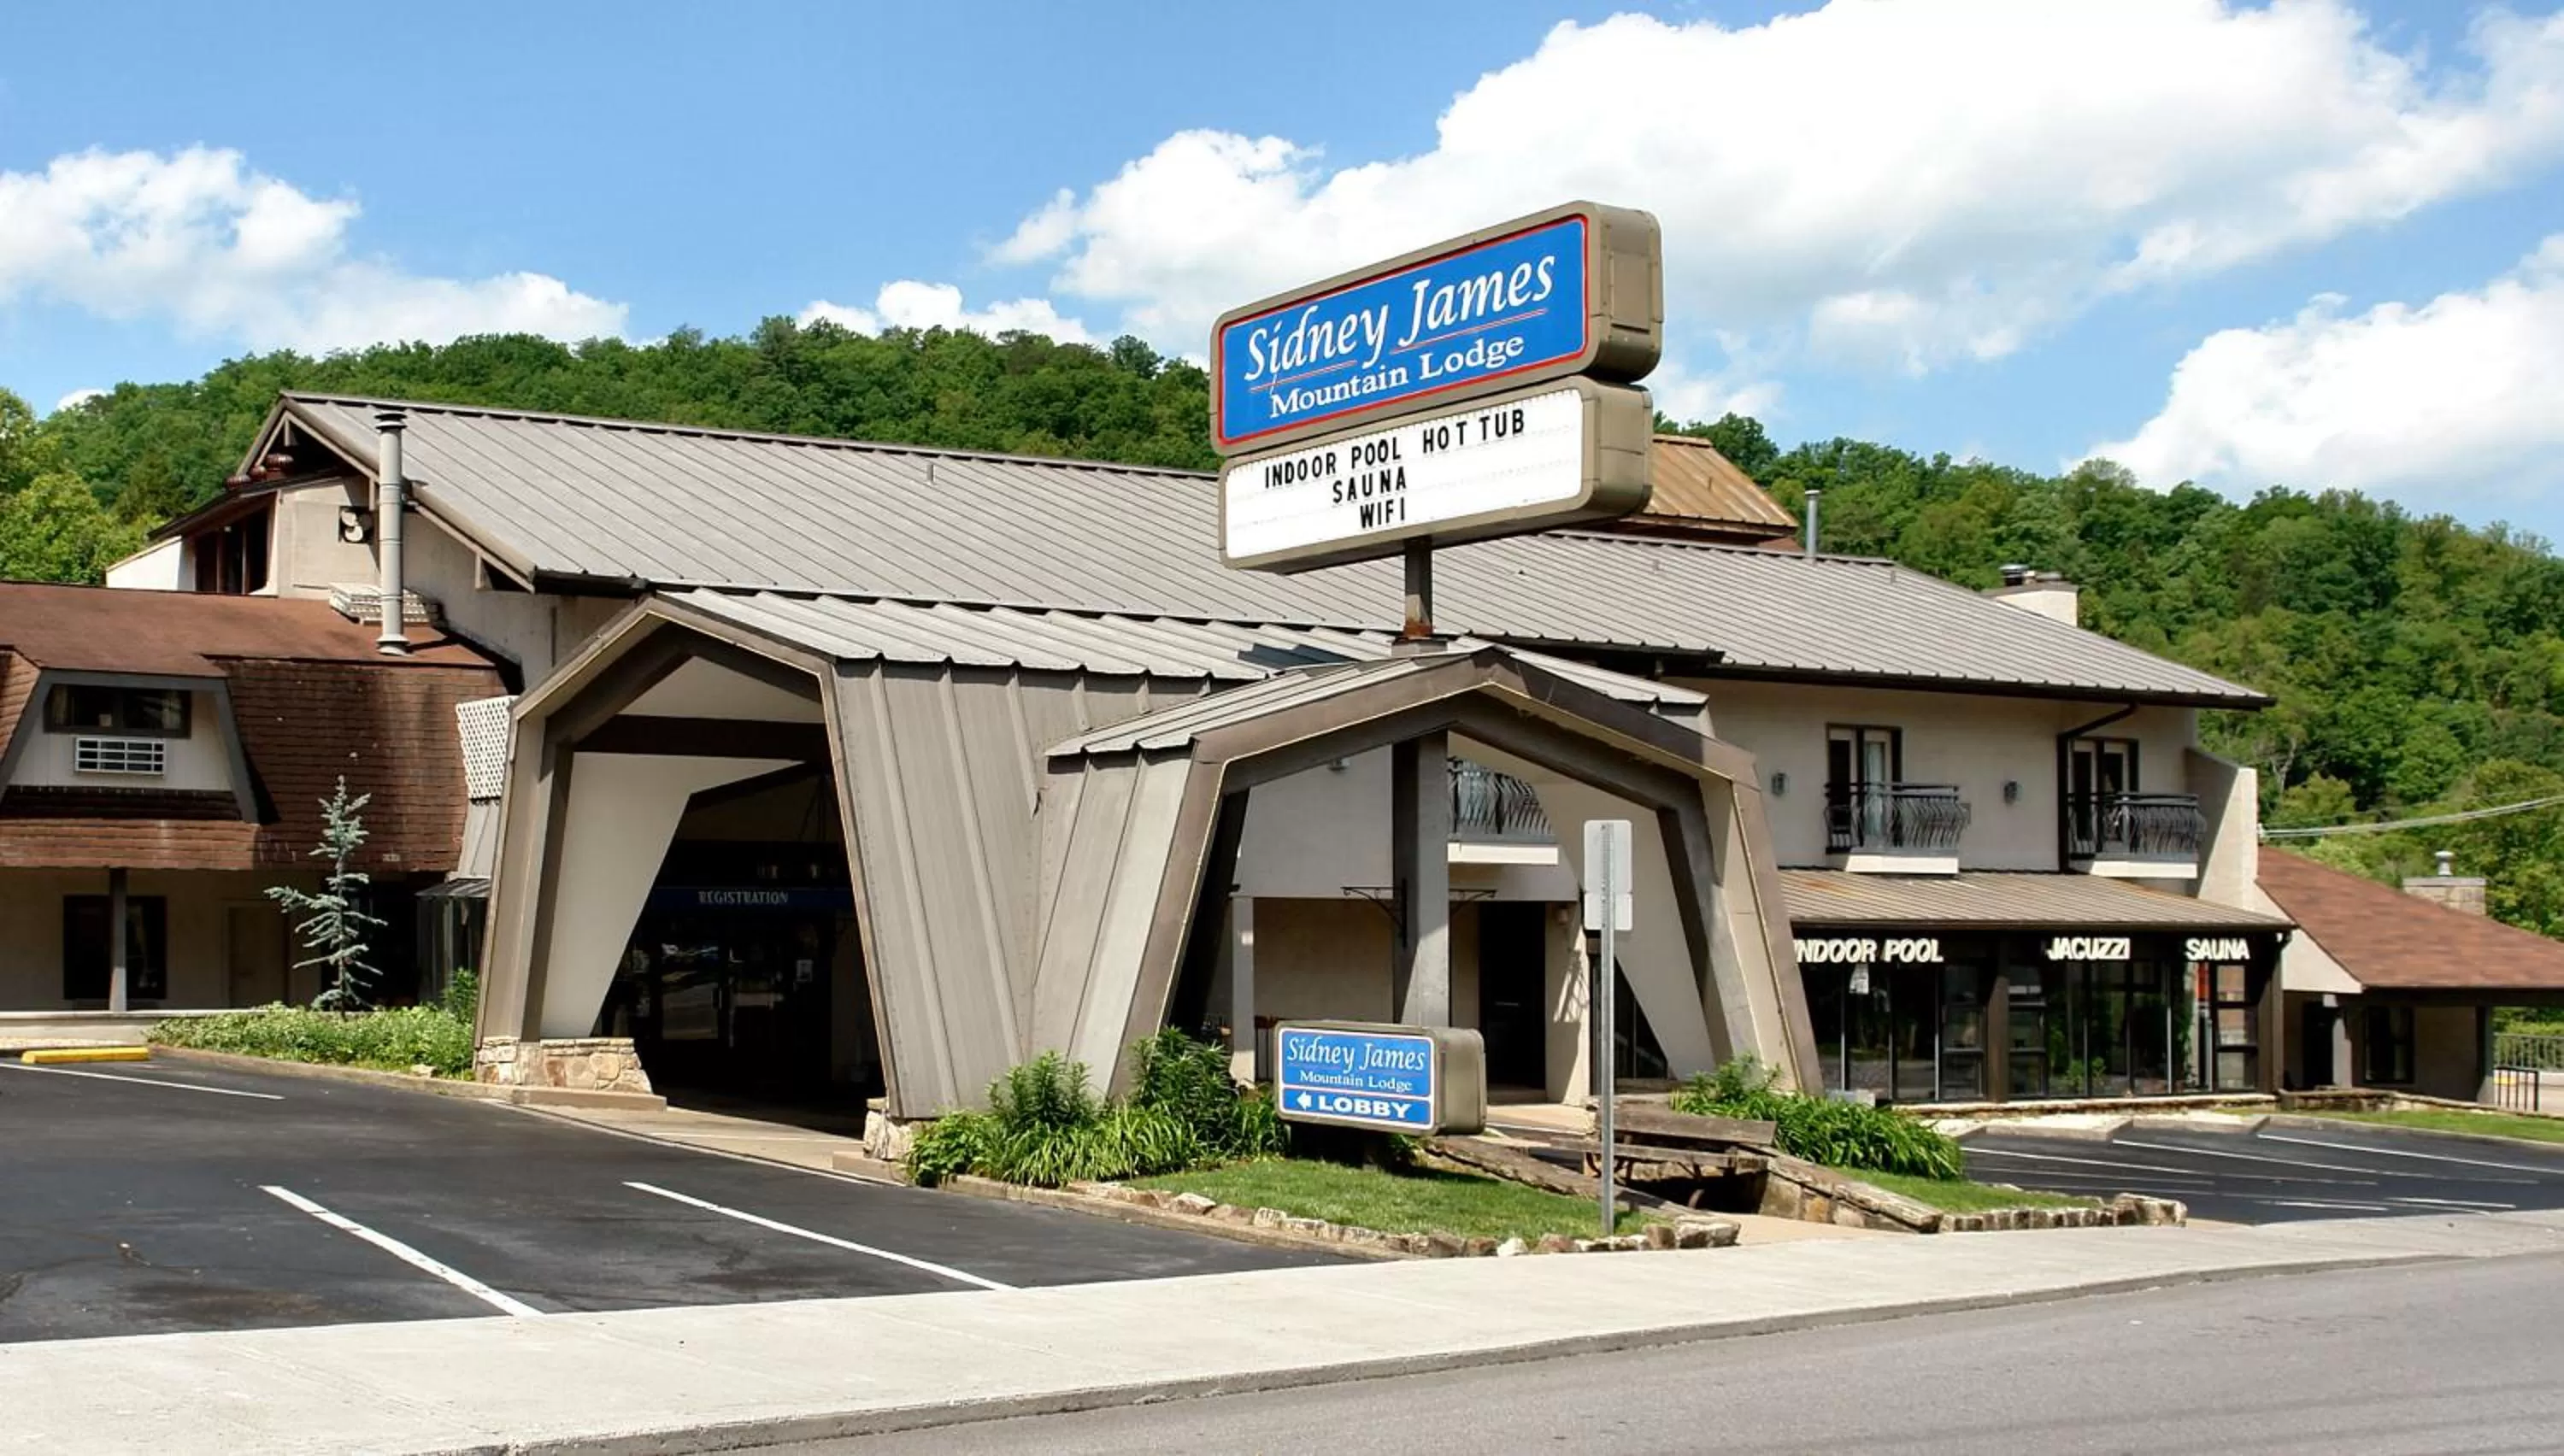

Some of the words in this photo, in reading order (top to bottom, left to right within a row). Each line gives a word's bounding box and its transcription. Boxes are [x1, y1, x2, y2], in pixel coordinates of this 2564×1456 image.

[1245, 305, 1391, 381] Sidney
[1398, 255, 1555, 346] James
[1270, 367, 1408, 417] Mountain
[1420, 335, 1525, 379] Lodge
[1265, 451, 1338, 489] INDOOR
[1351, 436, 1403, 471] POOL
[1422, 421, 1465, 455] HOT
[1479, 408, 1526, 443] TUB
[1332, 467, 1408, 503] SAUNA
[1359, 498, 1407, 530] WIFI
[698, 891, 788, 904] REGISTRATION
[1883, 938, 1944, 963] POOL
[2046, 936, 2131, 961] JACUZZI
[2185, 938, 2250, 960] SAUNA
[1287, 1036, 1355, 1073] Sidney
[1358, 1042, 1426, 1071] James
[1299, 1070, 1363, 1087] Mountain
[1368, 1075, 1413, 1092] Lodge
[1319, 1096, 1411, 1118] LOBBY
